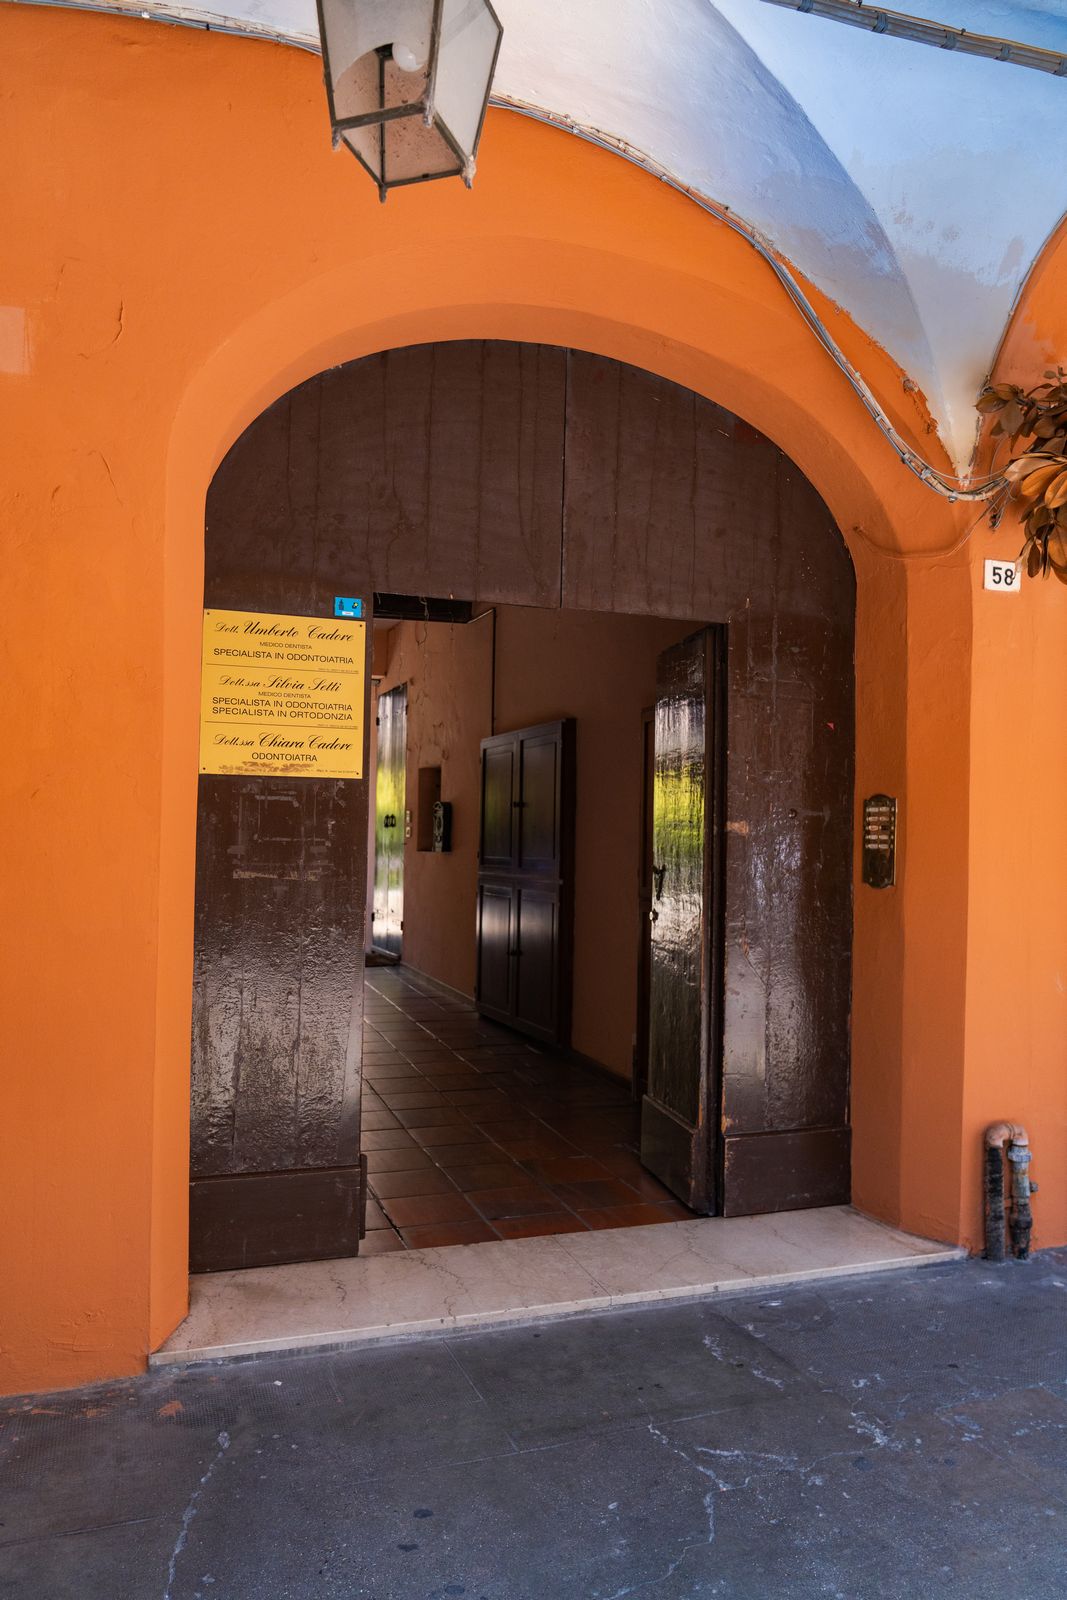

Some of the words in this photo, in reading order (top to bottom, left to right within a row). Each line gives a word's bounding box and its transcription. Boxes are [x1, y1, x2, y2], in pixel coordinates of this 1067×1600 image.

[992, 566, 1013, 586] 58
[243, 621, 299, 637] Umberto
[307, 625, 354, 641] Cadore
[214, 648, 272, 659] SPECIALISTA
[288, 653, 353, 664] ODONTOIATRIA
[263, 675, 304, 690] Silvia
[212, 697, 270, 707] SPECIALISTA
[286, 701, 352, 711] ODONTOIATRIA
[212, 707, 274, 716] SPECIALISTA
[290, 711, 352, 720] ORTODONZIA
[258, 732, 304, 748] Chiara
[308, 735, 352, 751] Cadore
[252, 752, 317, 762] ODONTOIATRA
